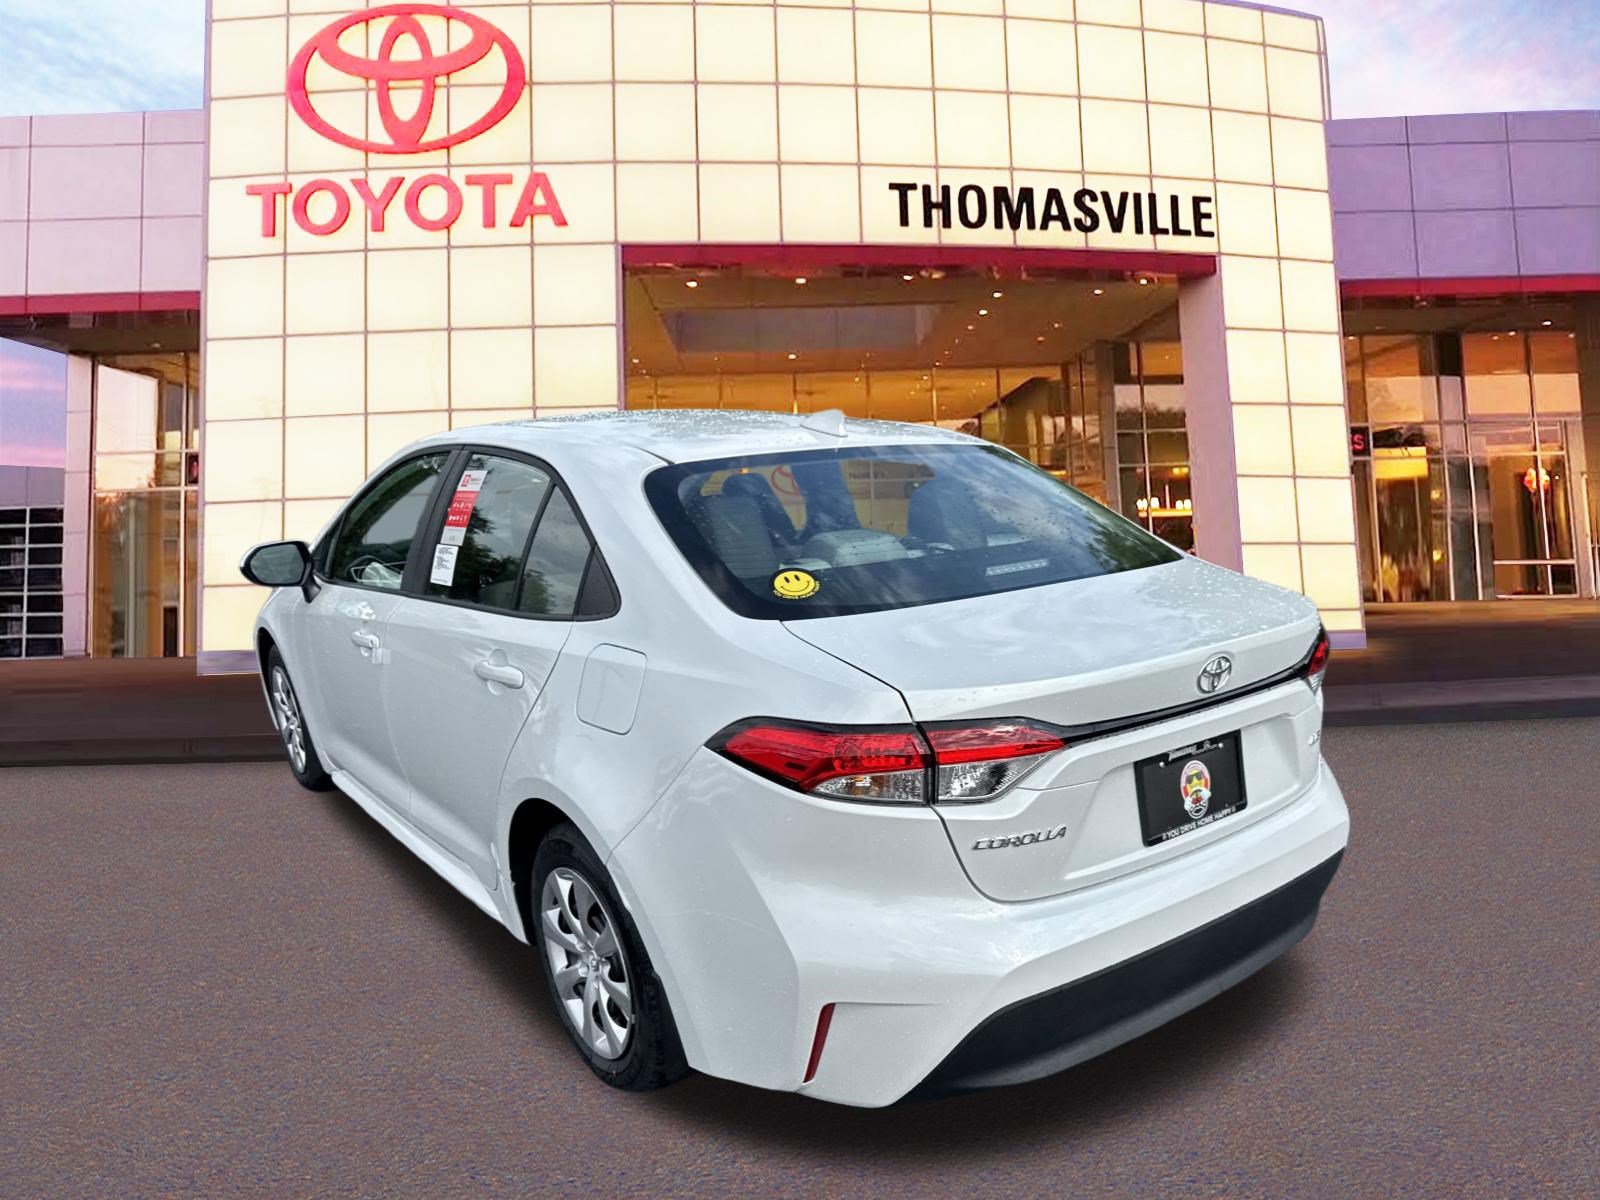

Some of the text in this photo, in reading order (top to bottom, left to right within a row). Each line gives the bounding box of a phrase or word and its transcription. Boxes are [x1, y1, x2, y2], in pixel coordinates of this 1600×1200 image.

[246, 171, 568, 238] TOYOTA
[888, 182, 1216, 239] THOMASVILLE
[971, 824, 1067, 851] COROLLA
[1166, 806, 1232, 839] YOU DRIVE HOME HAPPY
